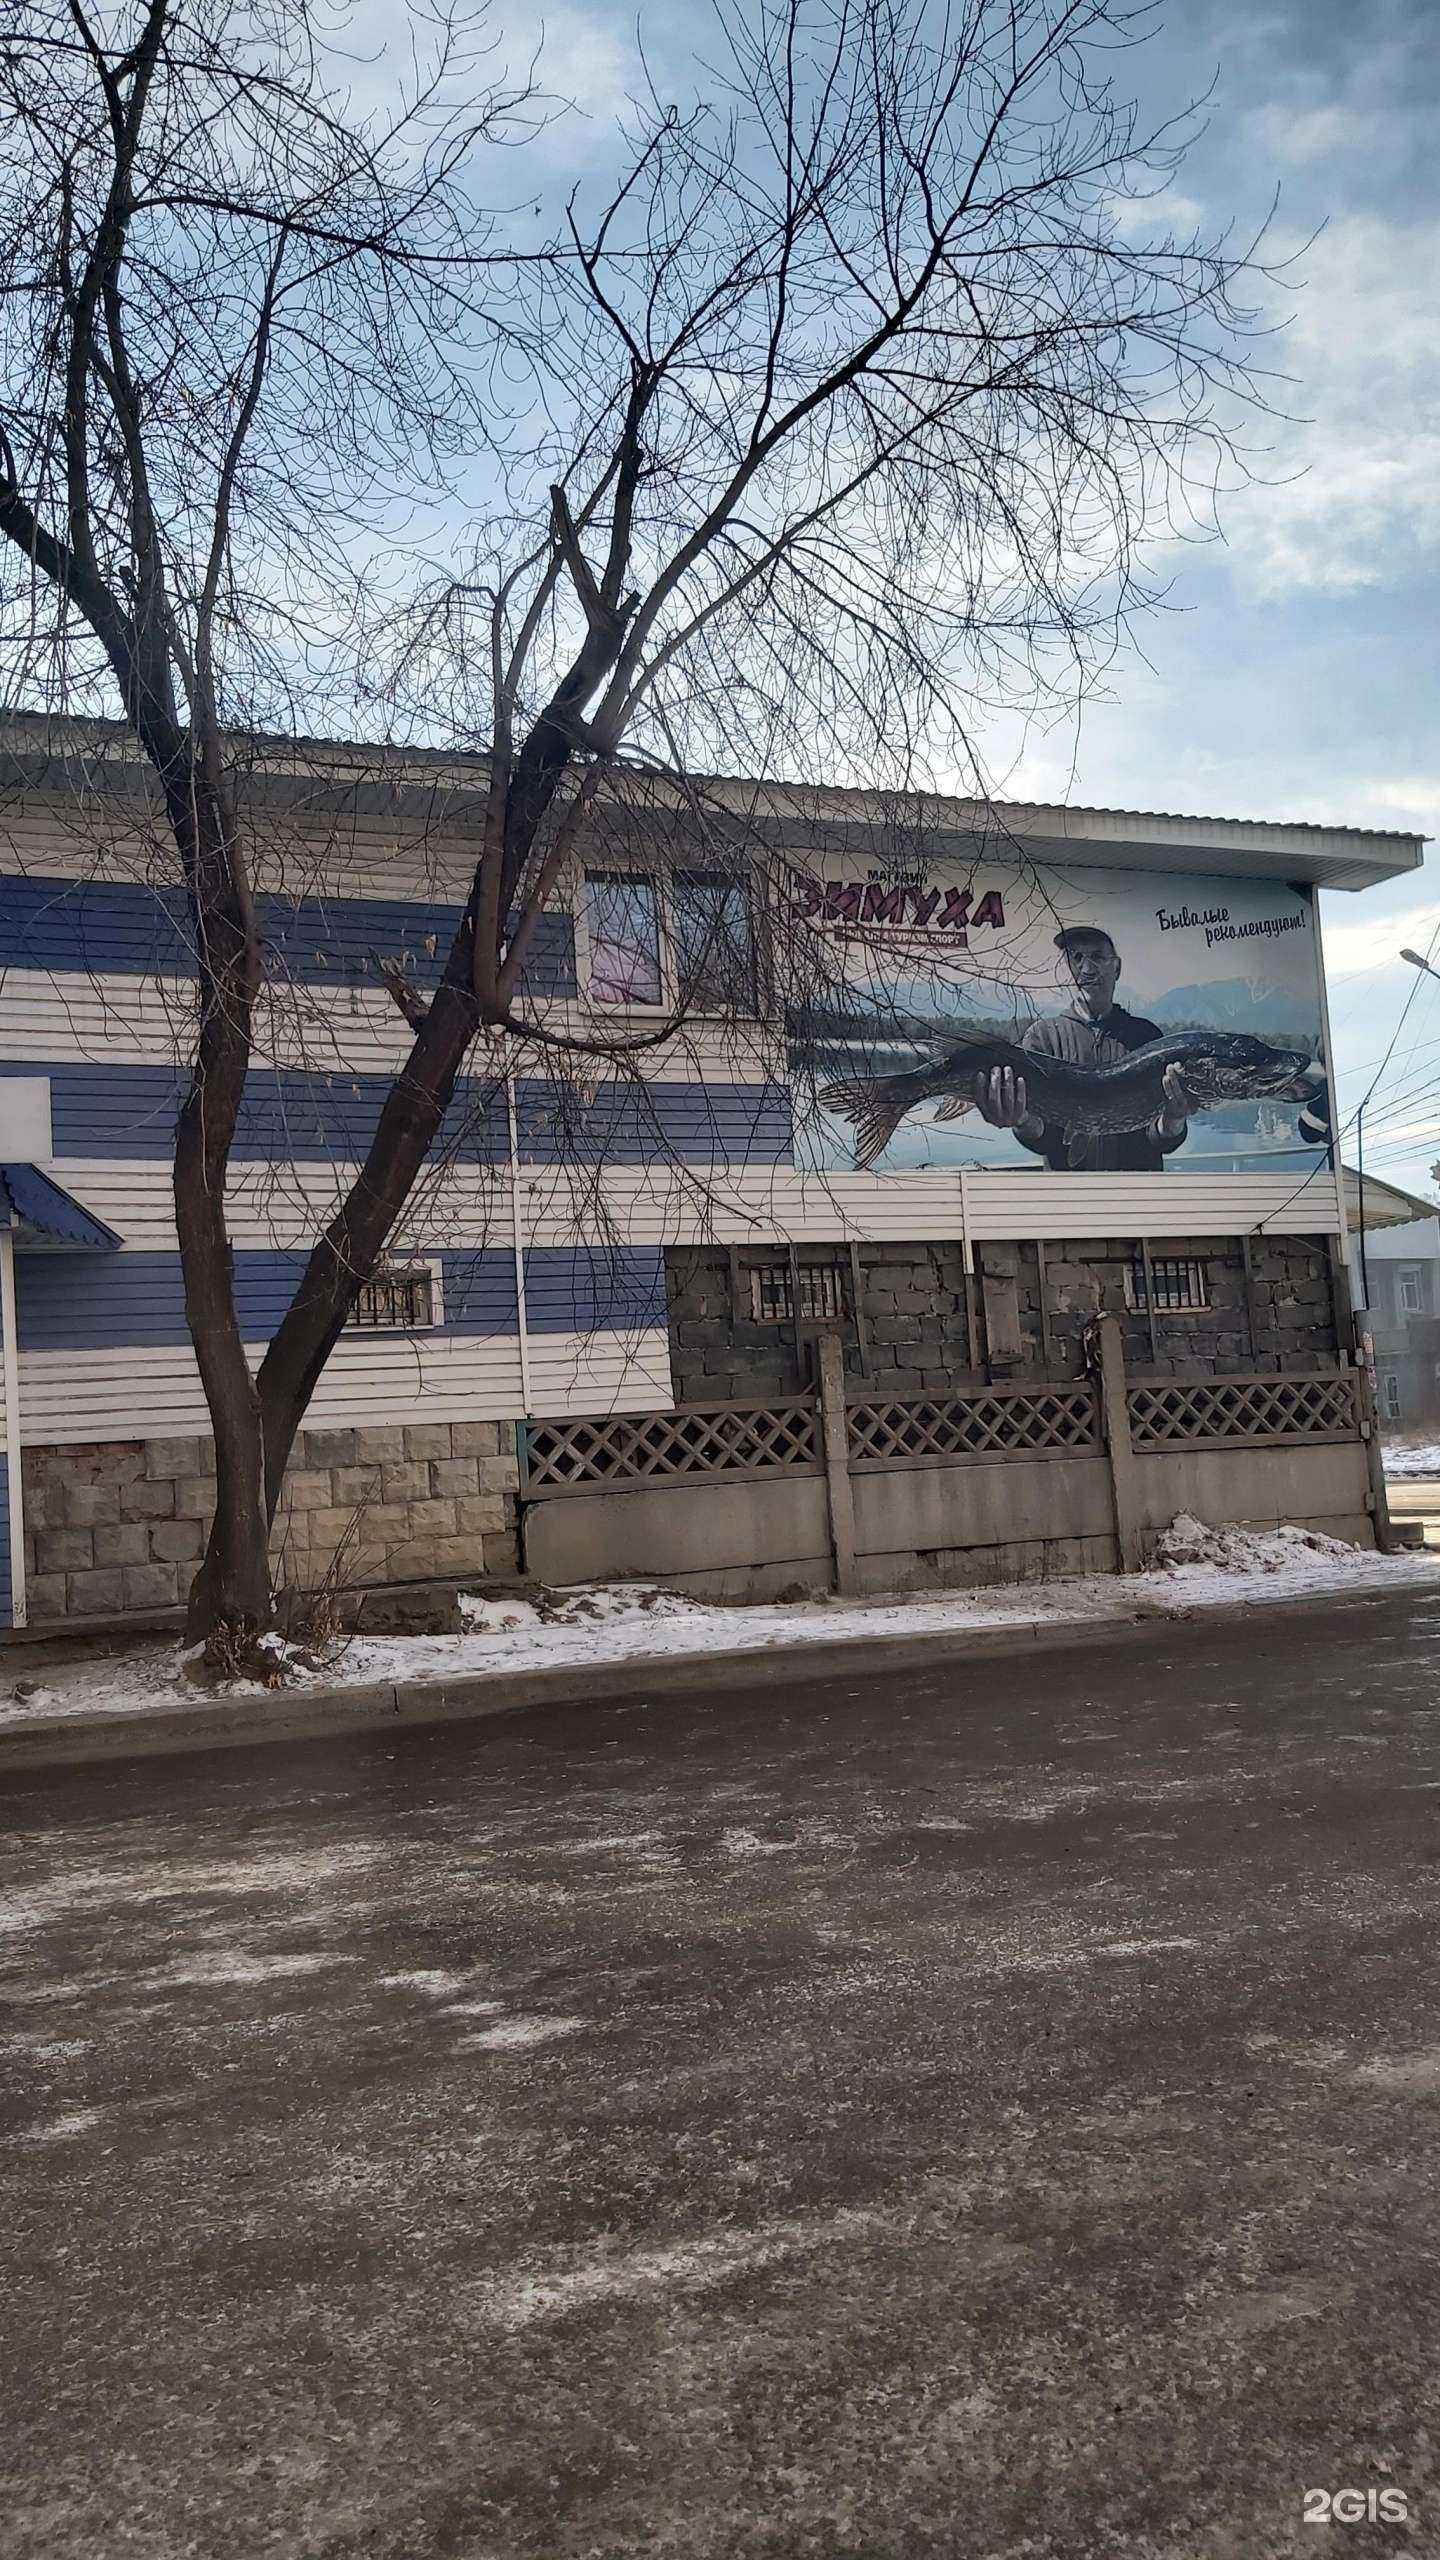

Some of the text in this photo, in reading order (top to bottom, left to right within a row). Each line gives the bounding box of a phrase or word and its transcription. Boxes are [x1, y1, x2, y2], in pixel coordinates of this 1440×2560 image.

[792, 876, 1005, 929] ЗИМУХА
[1156, 906, 1230, 931] Бывалые
[1205, 909, 1306, 948] рекомендуют!
